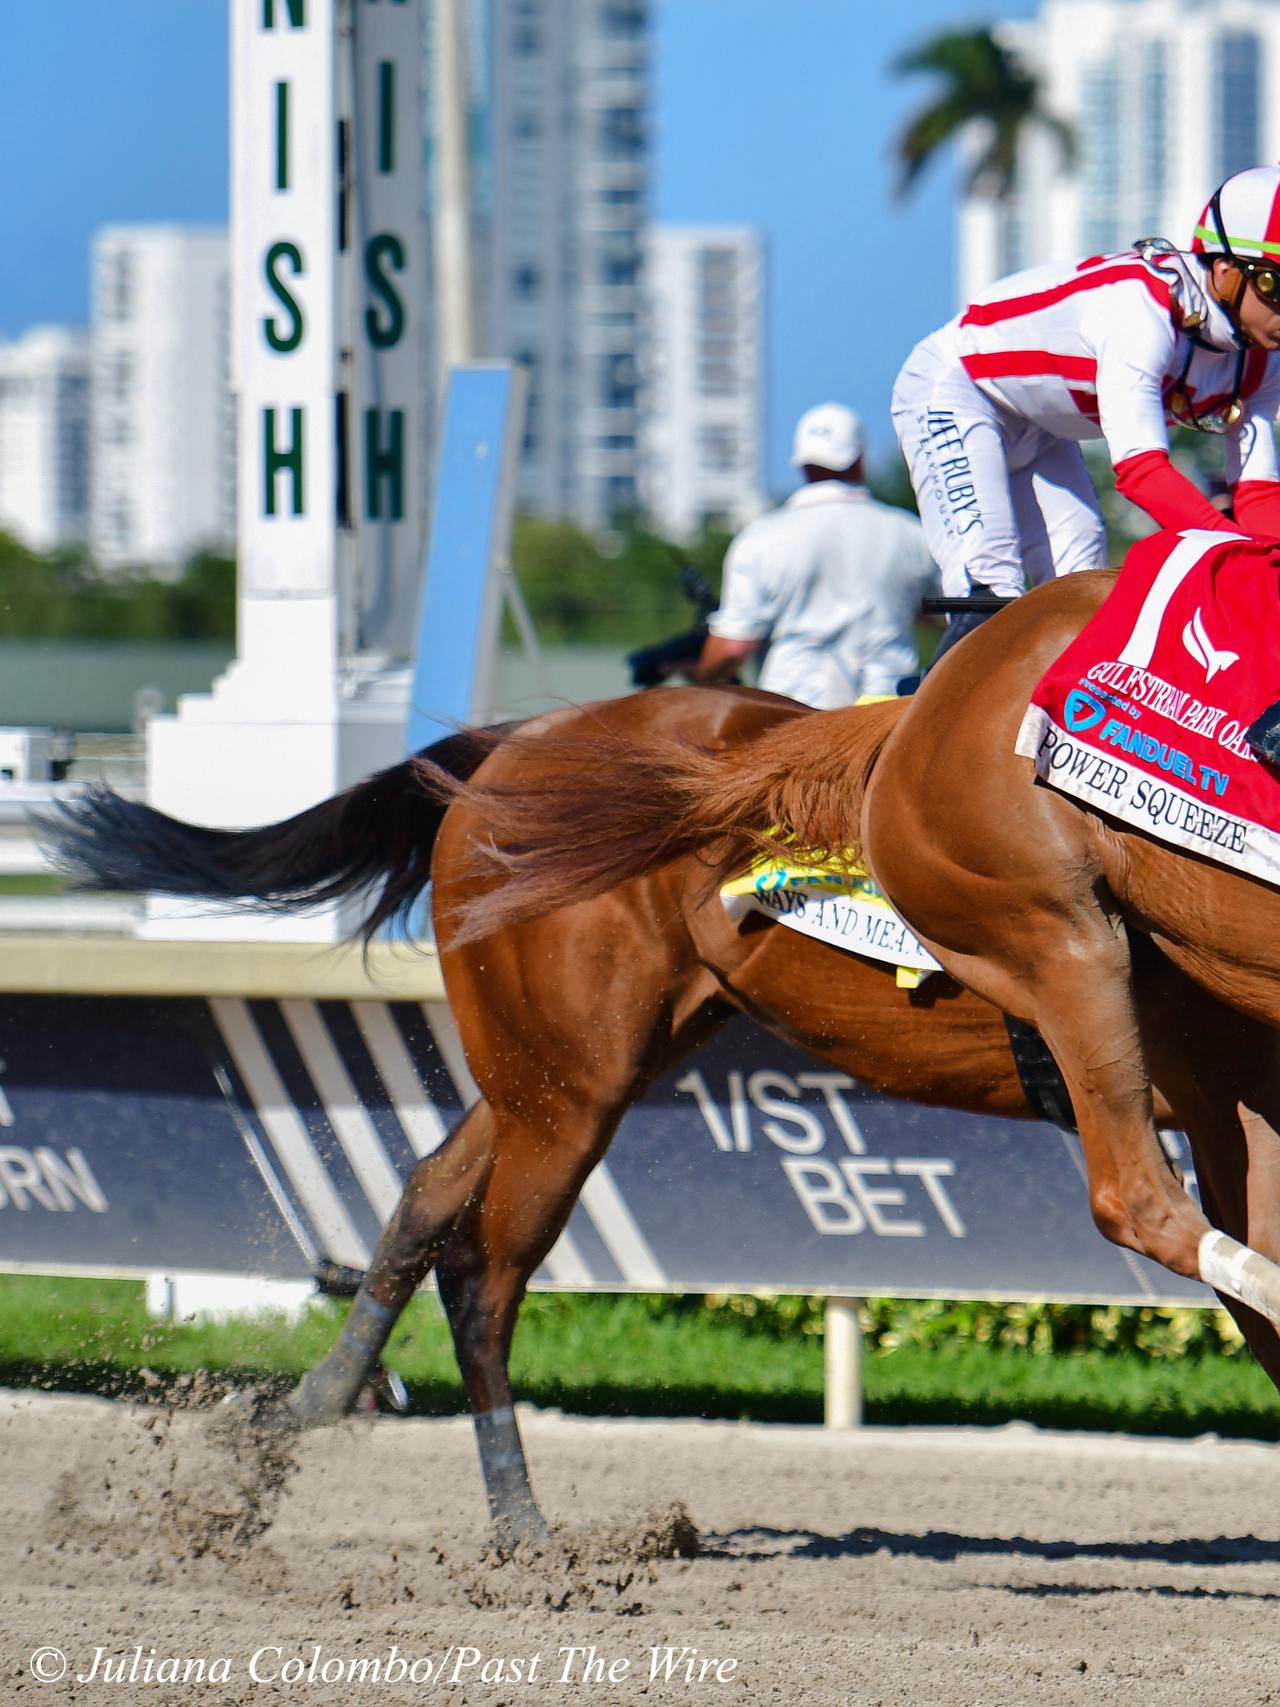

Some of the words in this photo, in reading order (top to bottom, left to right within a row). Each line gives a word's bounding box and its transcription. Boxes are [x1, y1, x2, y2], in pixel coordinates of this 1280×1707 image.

[263, 0, 304, 516] ISH
[939, 456, 985, 537] RUBY'S
[1117, 528, 1254, 669] 1
[1087, 661, 1190, 722] GULFSTREAM
[1181, 700, 1228, 739] PARK
[1128, 705, 1142, 720] by
[1037, 726, 1129, 800] POWER
[1130, 779, 1248, 854] SQUEEZE
[1099, 719, 1197, 786] FANDUEL
[1200, 766, 1231, 797] TV
[752, 889, 809, 920] WAYS
[811, 898, 858, 936] AND
[676, 1068, 868, 1156] 1/ST
[0, 1145, 110, 1213] RN
[780, 1155, 967, 1239] BET
